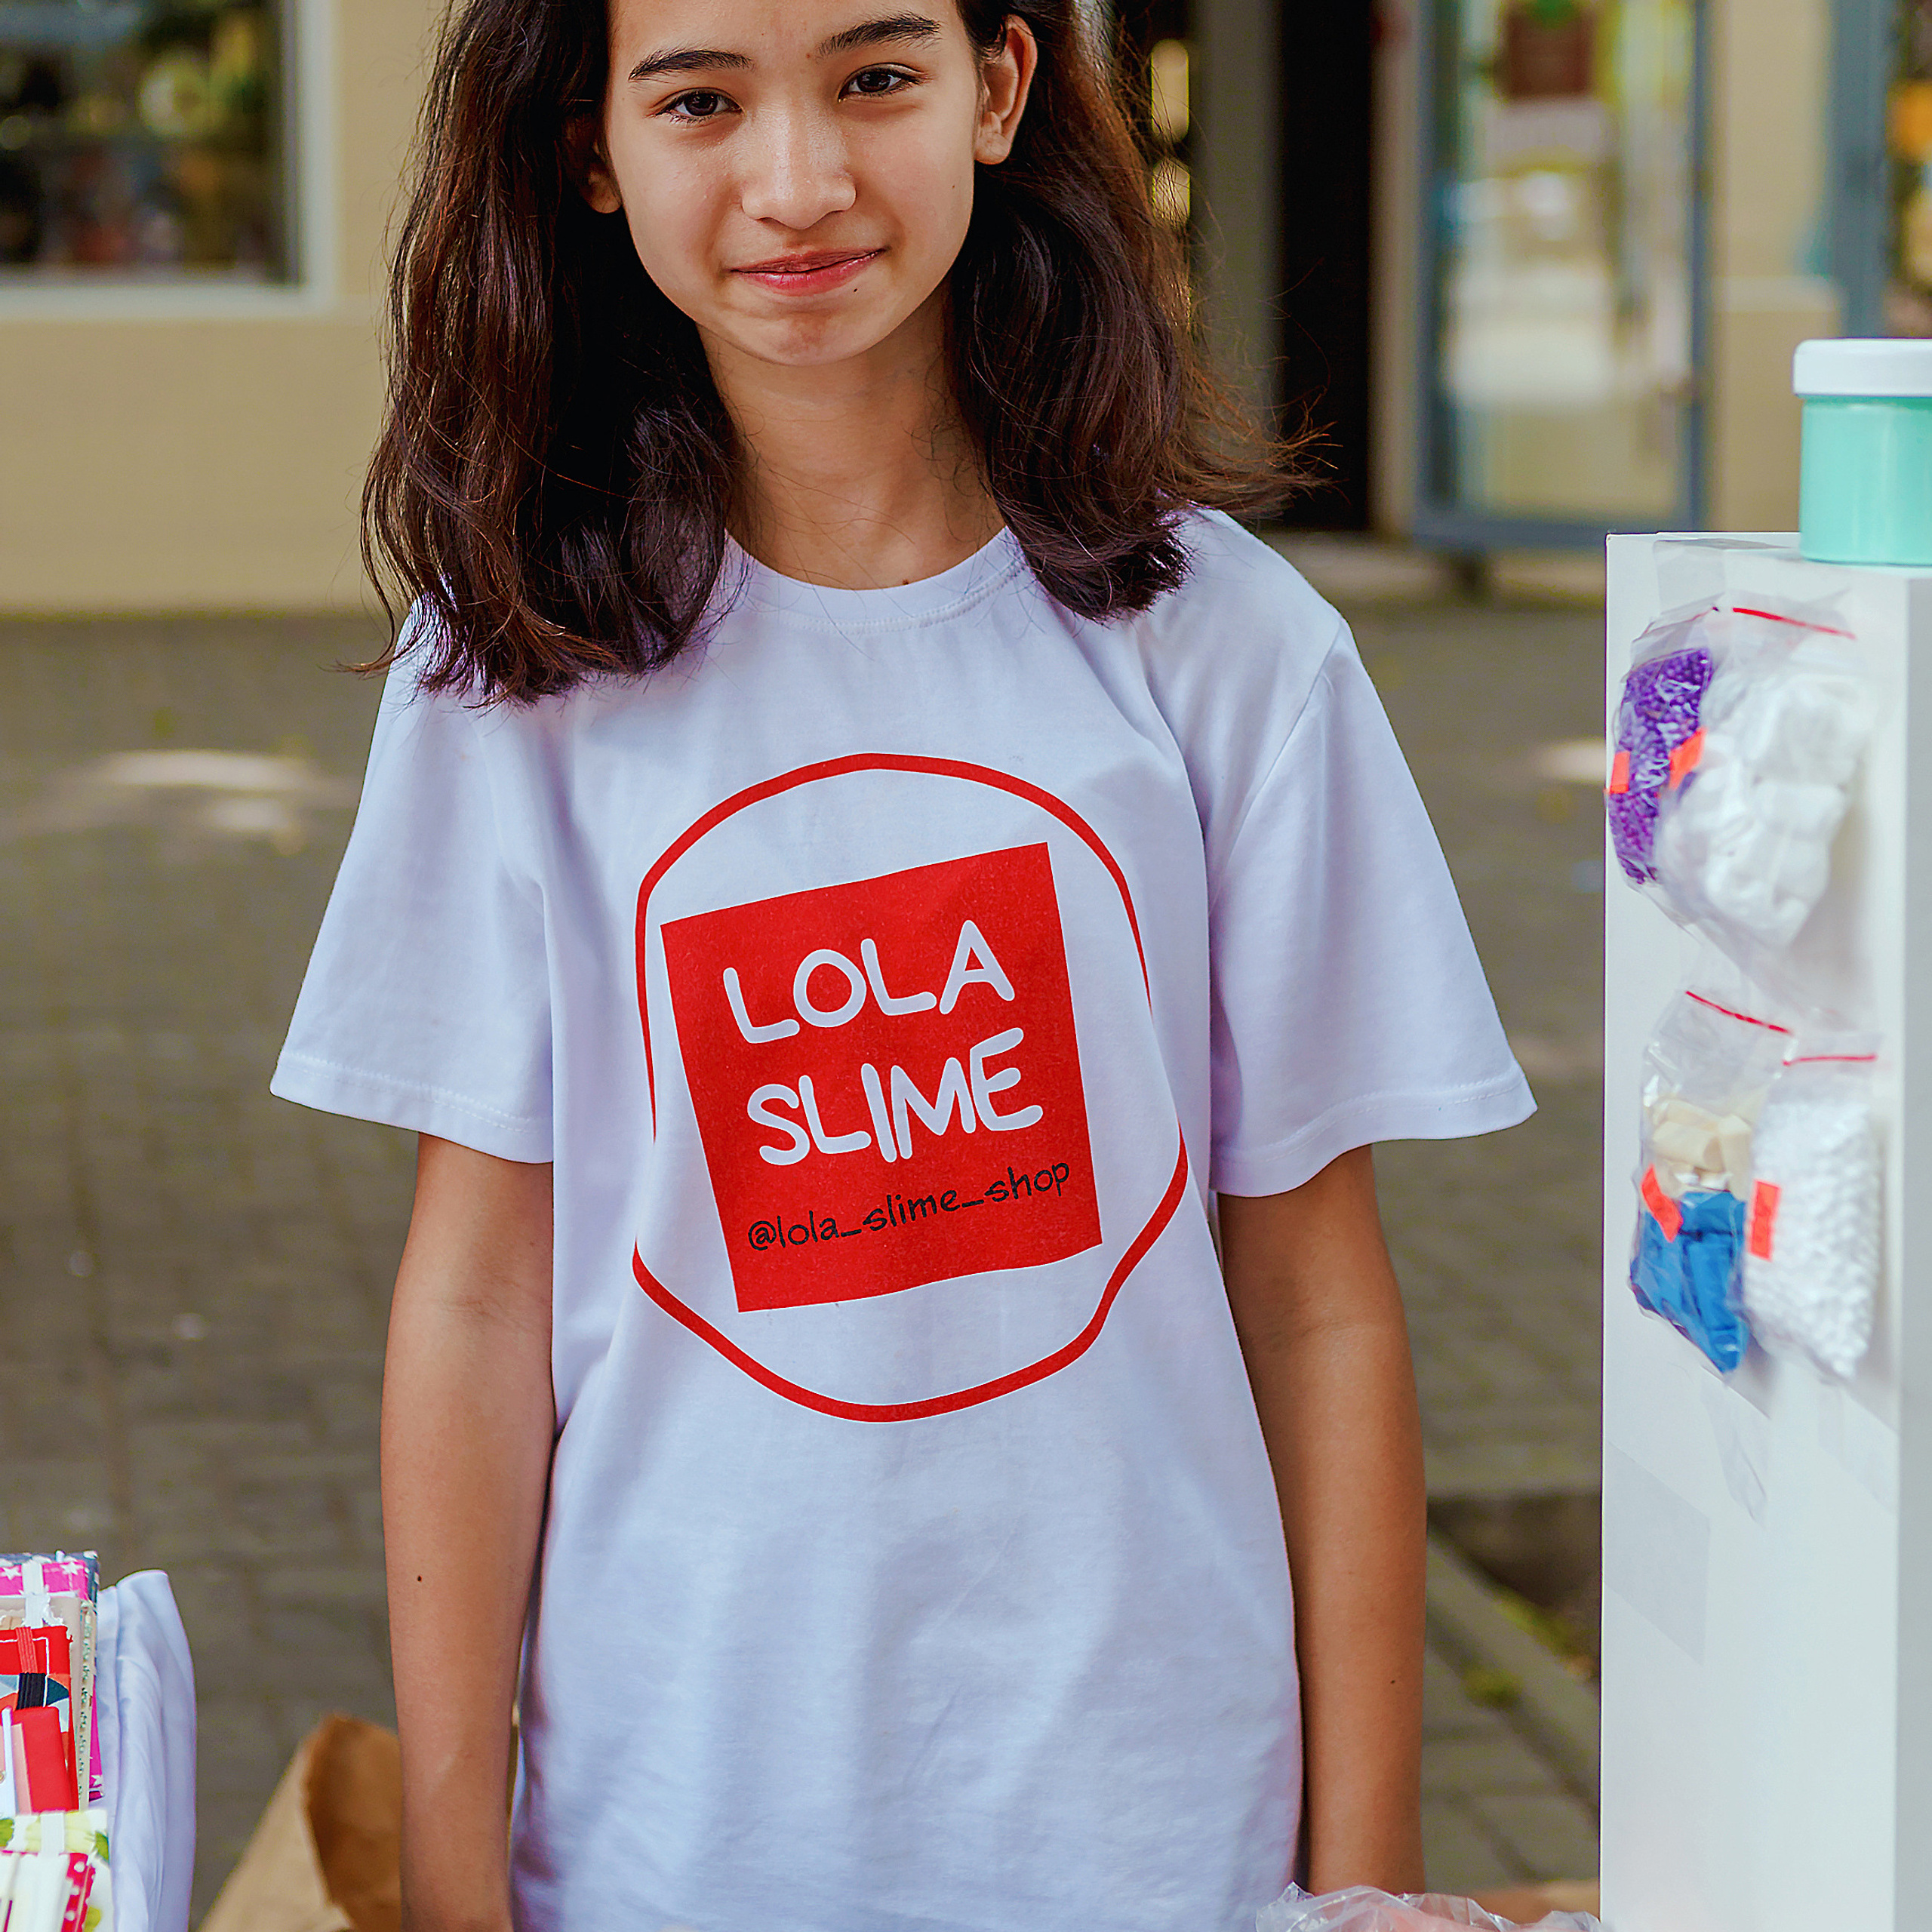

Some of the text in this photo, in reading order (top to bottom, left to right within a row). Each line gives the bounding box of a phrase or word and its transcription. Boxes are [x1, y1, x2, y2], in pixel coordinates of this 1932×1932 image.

[723, 920, 1015, 1044] LOLA
[746, 1027, 1043, 1165] SLIME
[748, 1162, 1070, 1251] @lola_slime_shop
